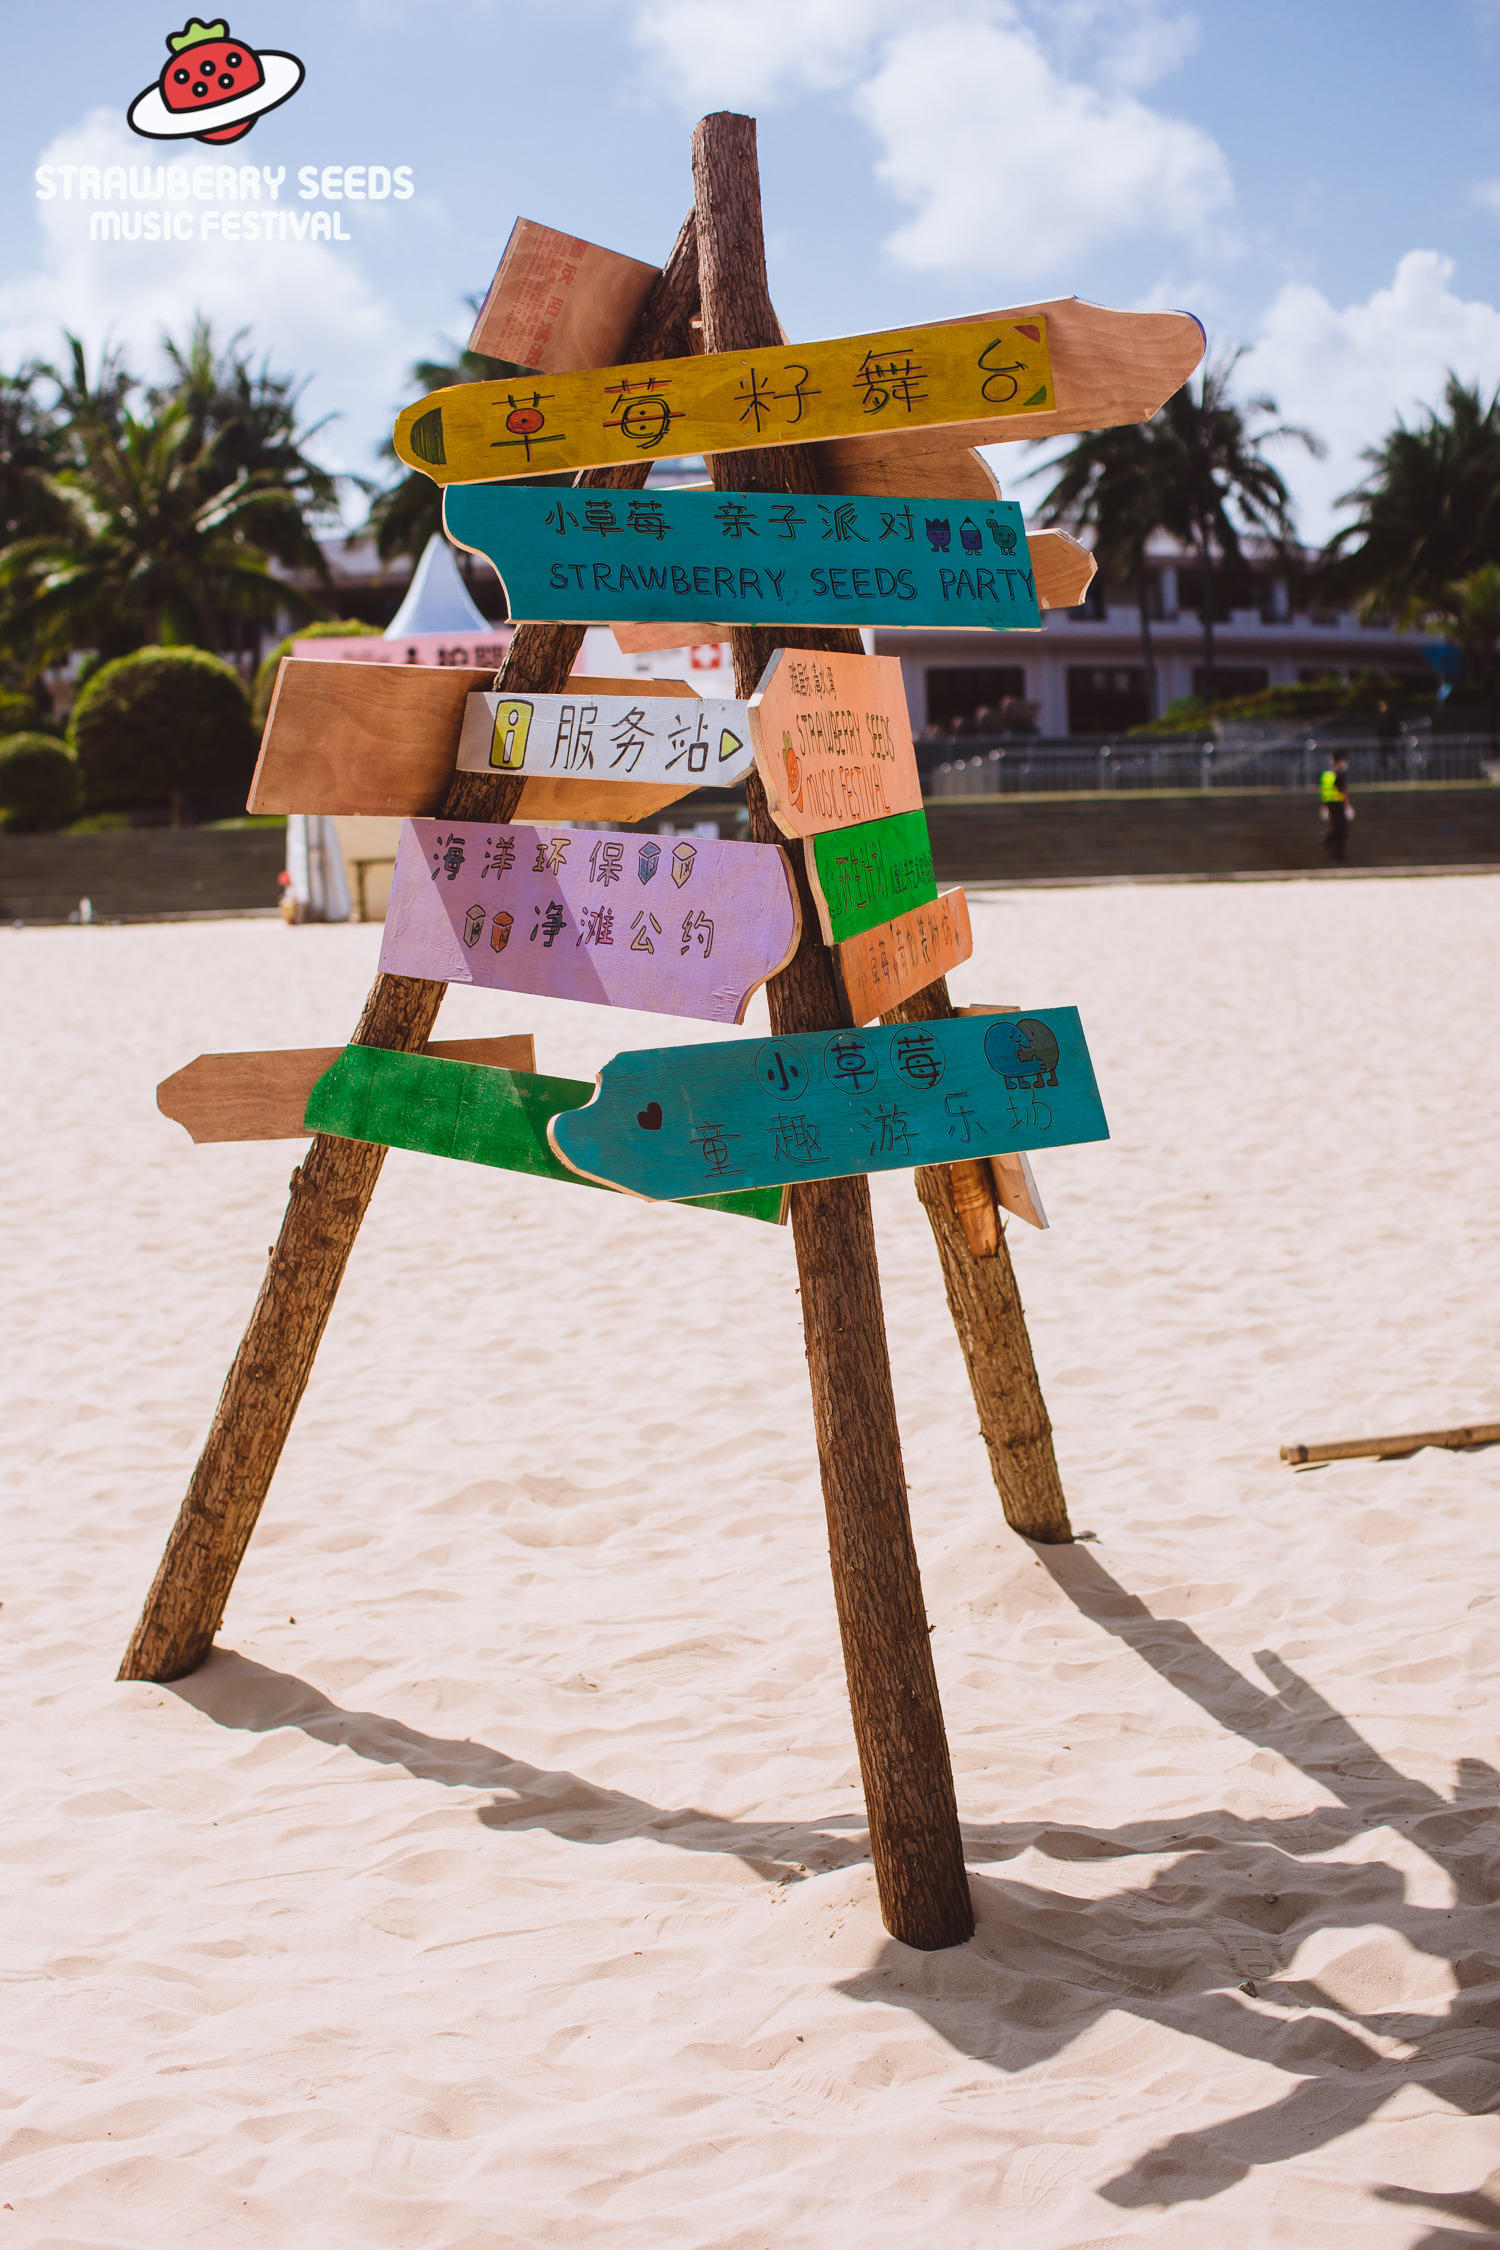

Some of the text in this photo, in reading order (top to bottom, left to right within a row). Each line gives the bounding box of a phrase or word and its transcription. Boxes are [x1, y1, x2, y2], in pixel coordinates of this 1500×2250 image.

[544, 499, 915, 543] 小草莓 亲子派对
[550, 562, 1037, 602] STRAWBERRY SEEDS PARTY
[550, 705, 709, 773] 服务站
[796, 709, 896, 762] STRAWBERRY SEEDS
[807, 763, 891, 821] MUSIC FESTIVAL
[431, 833, 624, 887] 海洋环保
[530, 901, 715, 959] 净滩公约
[768, 1034, 942, 1091] 小草莓
